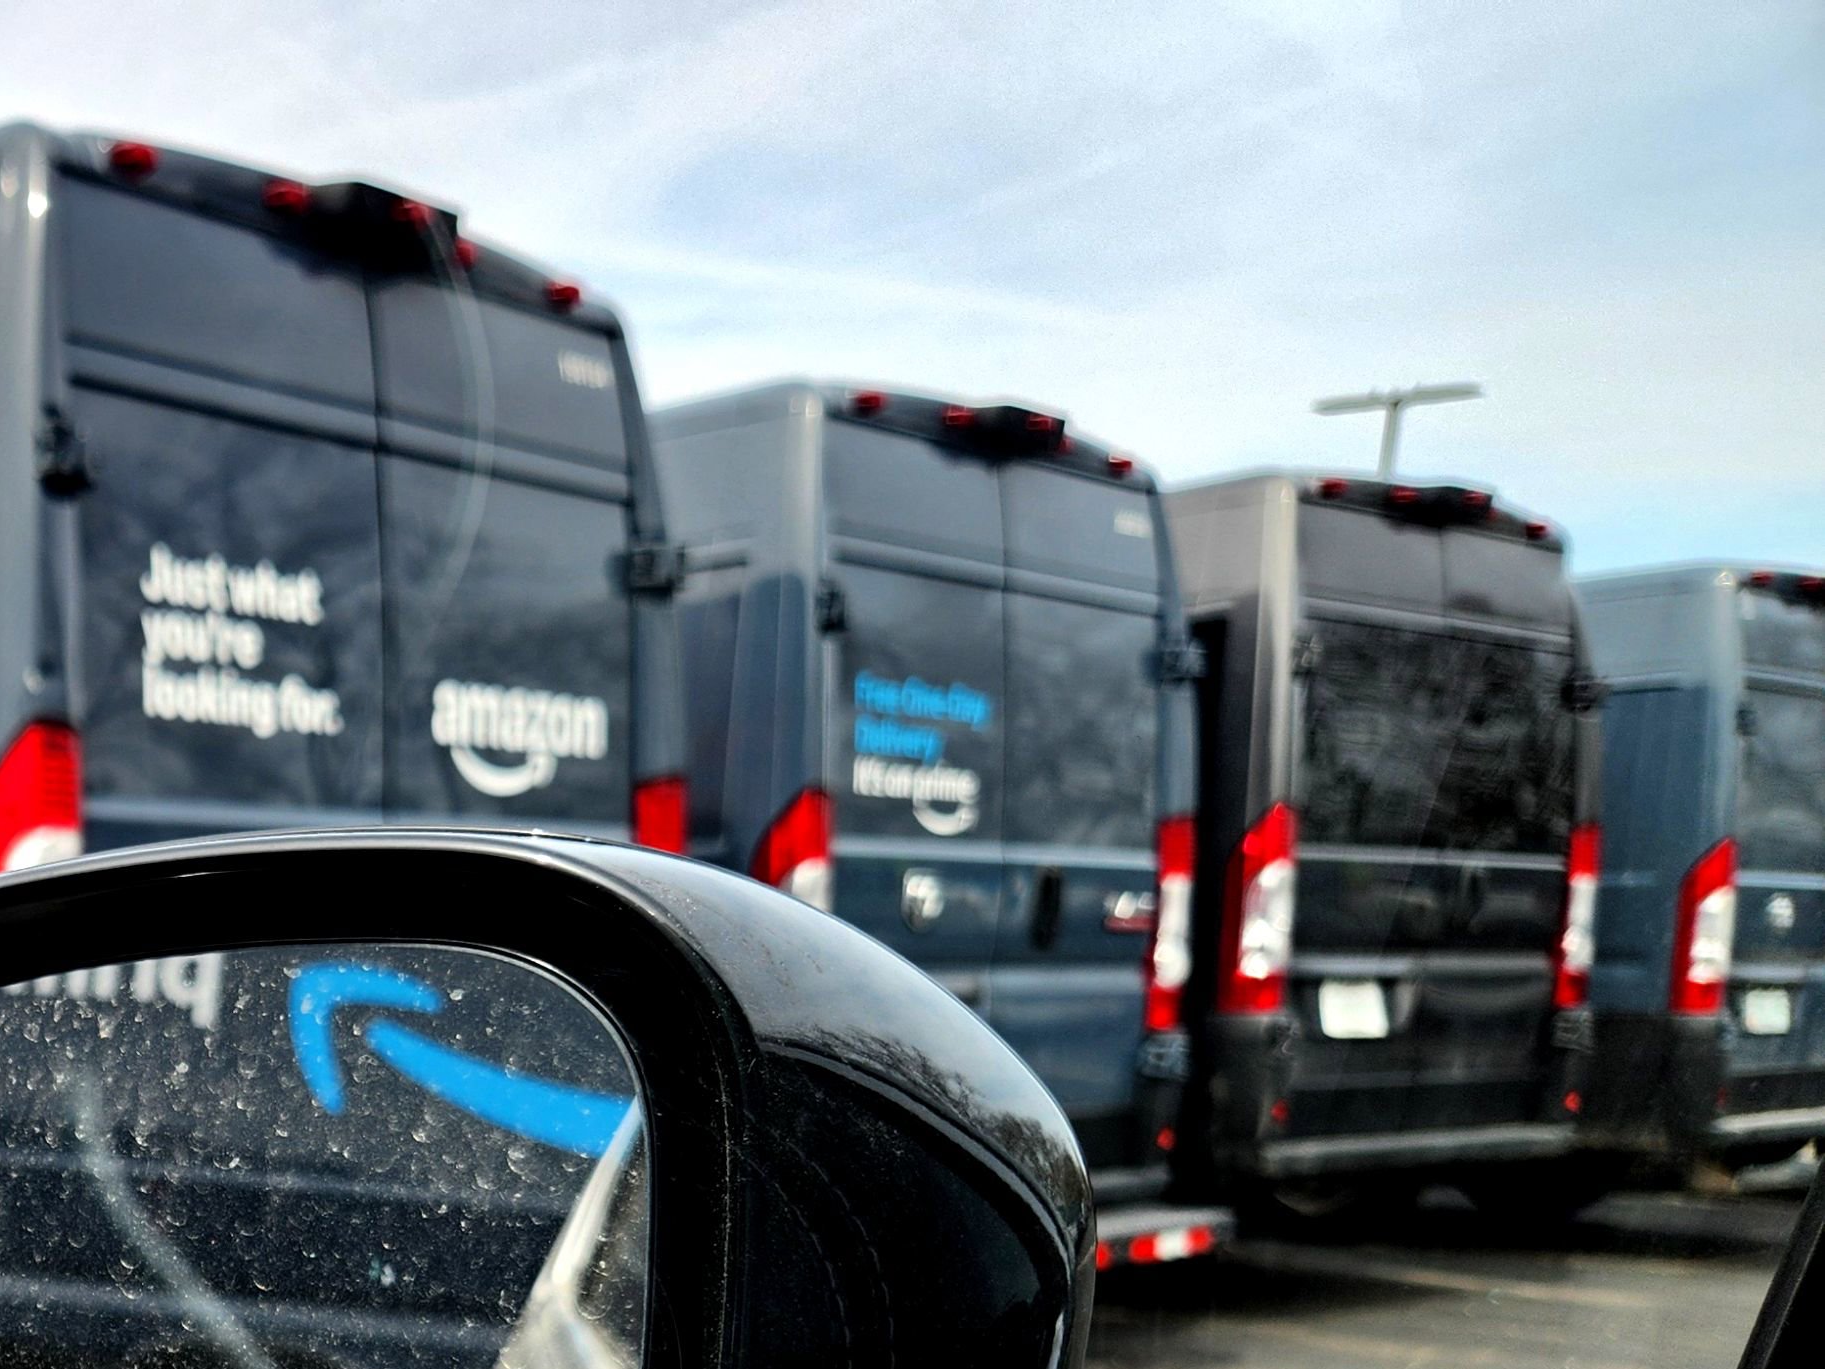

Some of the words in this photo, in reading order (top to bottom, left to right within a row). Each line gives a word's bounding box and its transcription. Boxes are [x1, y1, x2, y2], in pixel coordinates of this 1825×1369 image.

[140, 541, 227, 611] Just
[228, 559, 324, 626] what
[142, 664, 278, 738] looking
[432, 678, 608, 760] amazon
